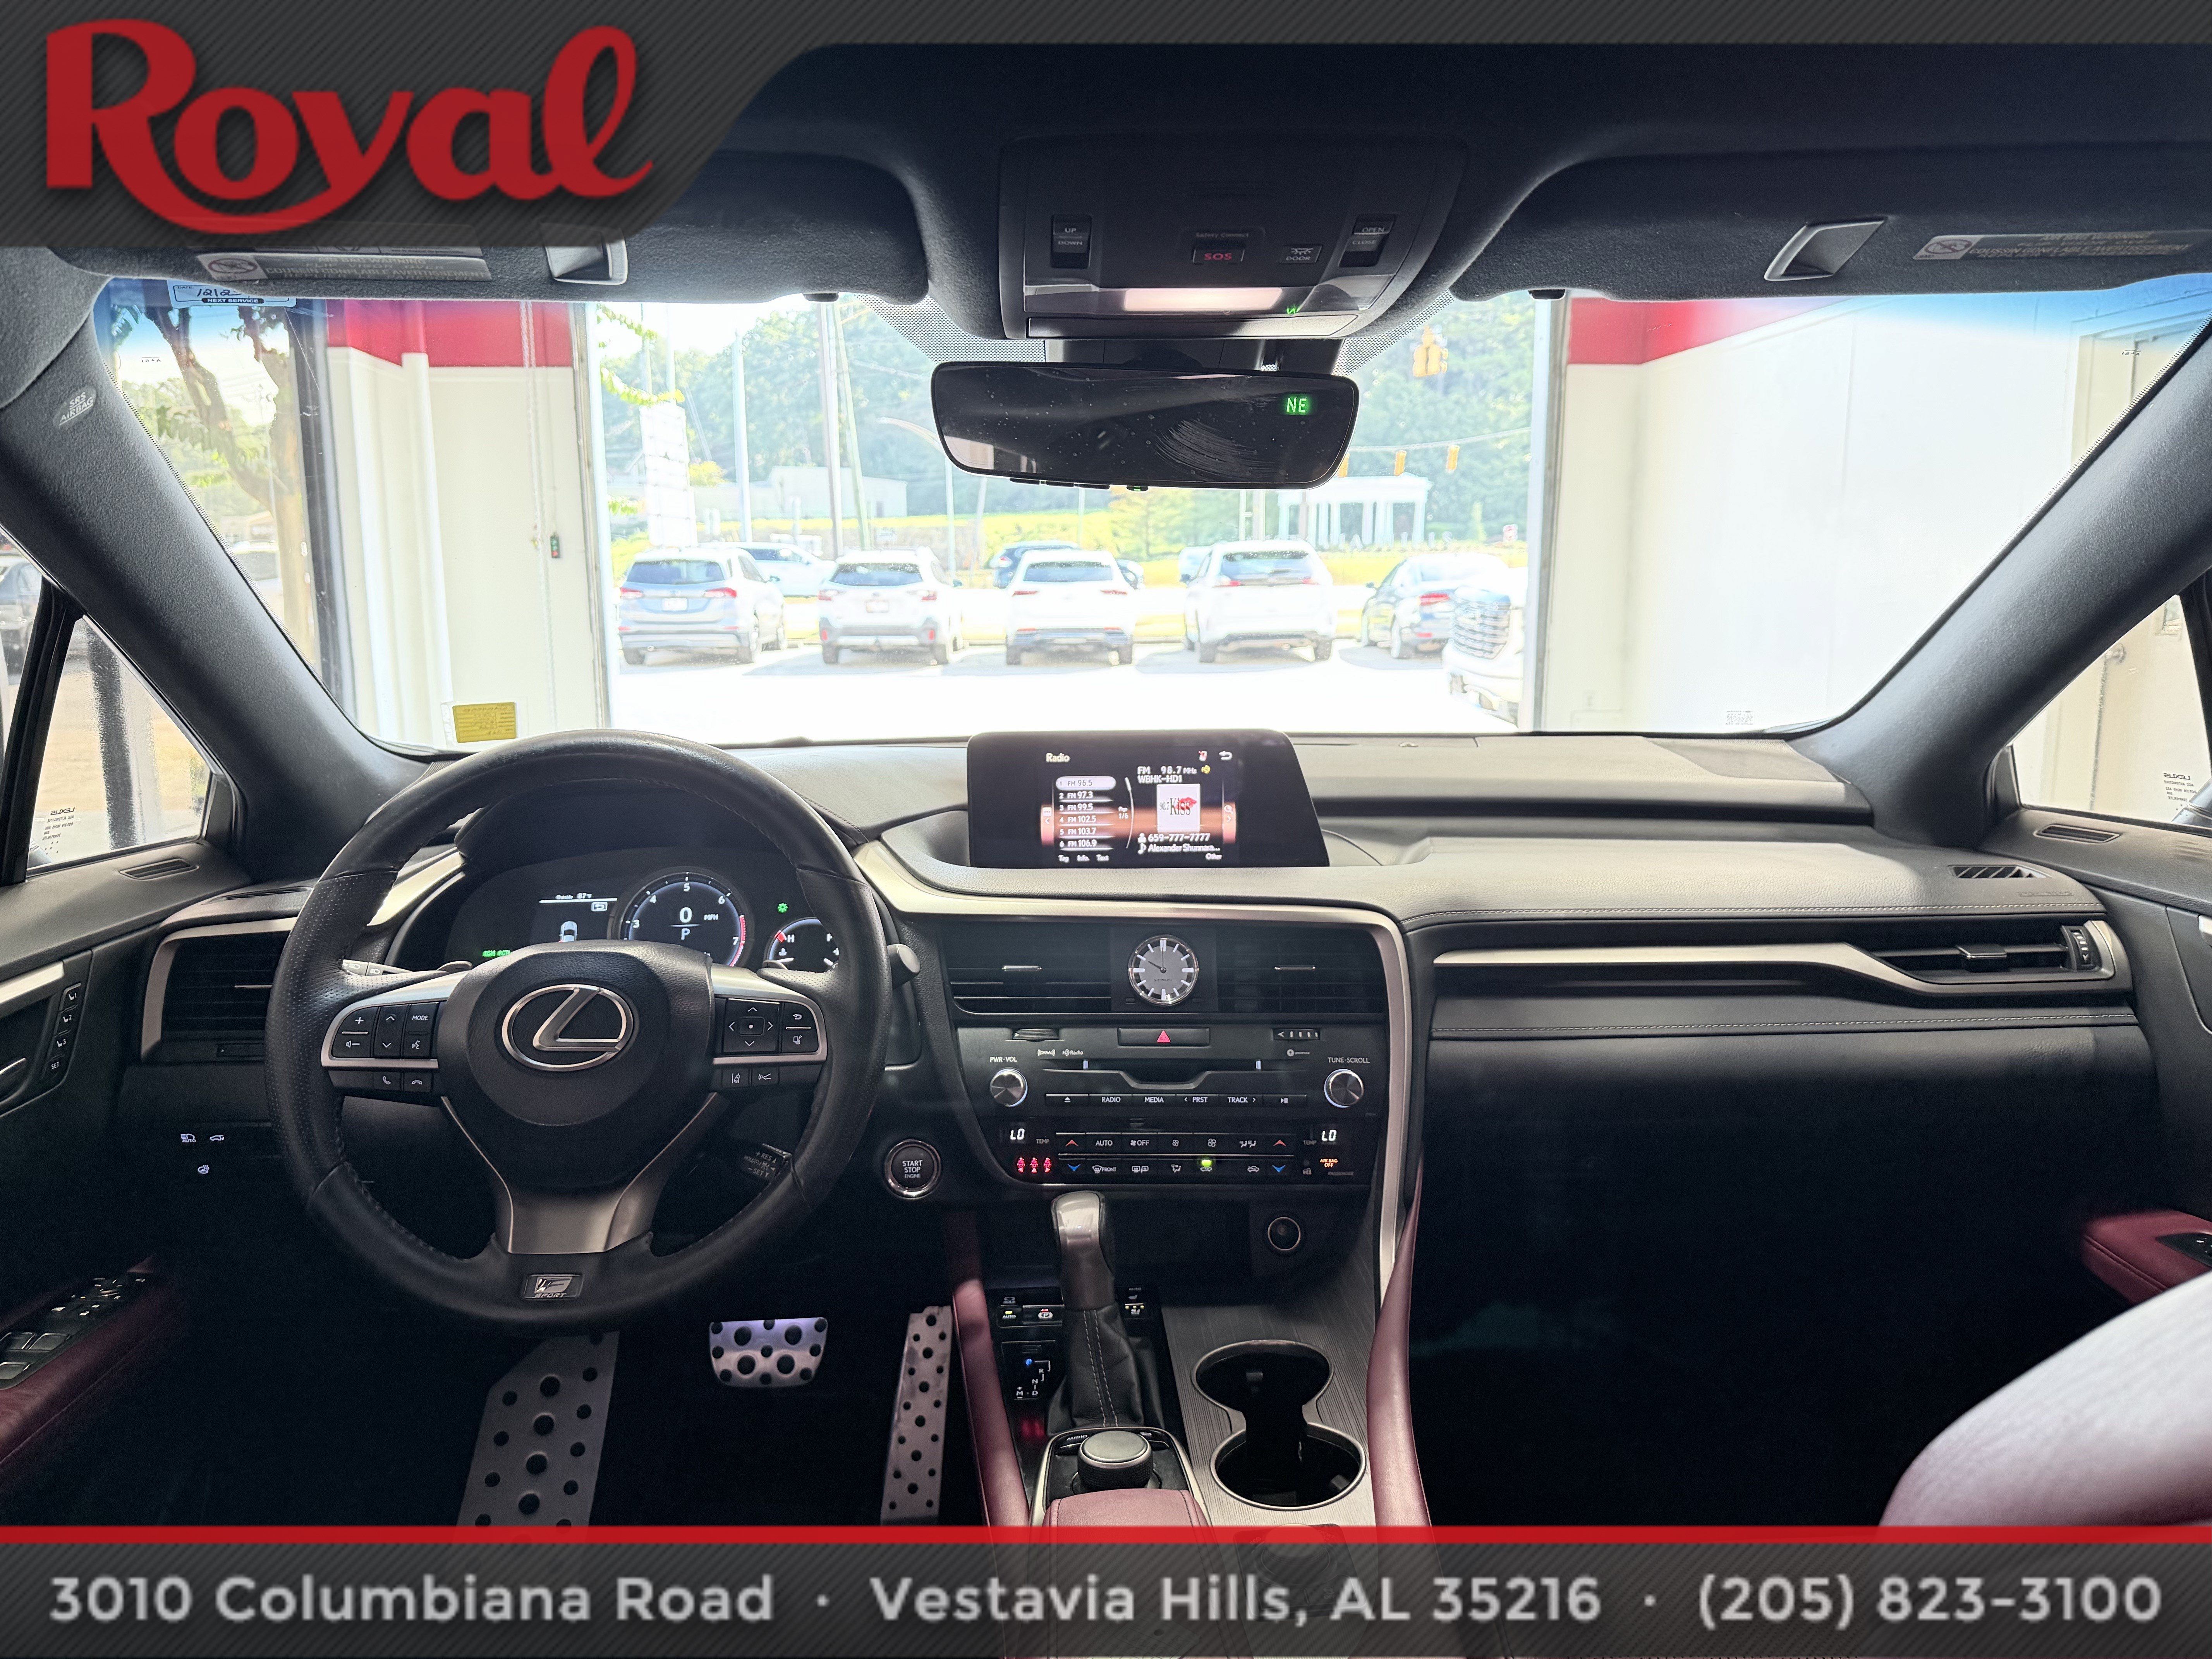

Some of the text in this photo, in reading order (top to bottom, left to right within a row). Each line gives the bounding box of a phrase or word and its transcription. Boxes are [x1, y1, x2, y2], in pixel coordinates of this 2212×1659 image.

[69, 392, 86, 408] SRS
[60, 396, 93, 422] AIRBAG
[1287, 397, 1307, 413] NE
[1046, 752, 1070, 763] Radio
[1137, 766, 1151, 775] FM
[1161, 766, 1182, 774] 98.7
[1137, 775, 1183, 784] WBHK-HD1
[1170, 797, 1191, 815] Kiss
[1148, 833, 1211, 842] 659-777-7777
[1078, 839, 1097, 847] 106.9
[1148, 844, 1182, 852] Alexander
[684, 883, 690, 892] 5
[649, 895, 656, 903] 4
[718, 895, 725, 904] 6
[680, 907, 692, 923] 0
[632, 919, 640, 928] 3
[681, 928, 690, 940] P
[787, 934, 795, 943] H
[732, 936, 739, 945] 7
